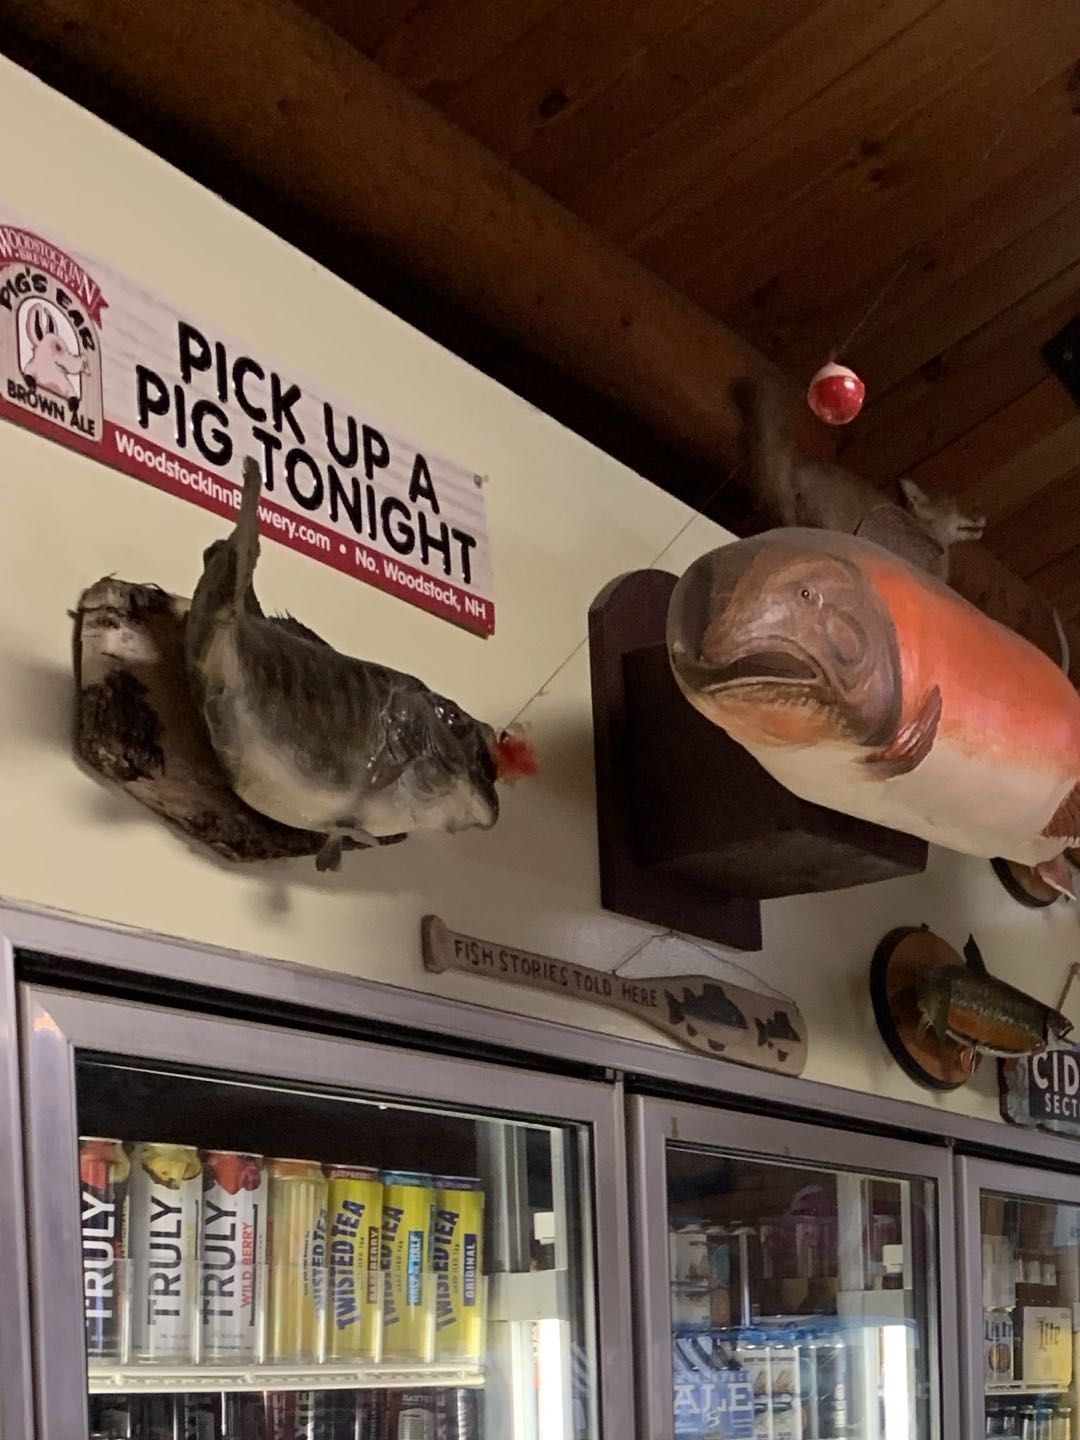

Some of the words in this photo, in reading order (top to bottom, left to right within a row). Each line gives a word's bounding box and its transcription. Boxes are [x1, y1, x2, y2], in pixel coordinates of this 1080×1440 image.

[7, 378, 66, 422] BROWN
[70, 411, 96, 438] ALE
[178, 320, 305, 444] PICK
[322, 401, 390, 482] UP
[408, 451, 440, 514] A
[114, 430, 330, 552] WoodstockInnBwery.com
[355, 549, 380, 575] No.
[383, 560, 462, 613] Woodstock,
[464, 597, 487, 622] NH
[134, 364, 234, 467] PIG
[251, 425, 477, 585] TONIGHT
[454, 938, 494, 967] FISH
[499, 953, 568, 987] STORIES
[572, 969, 612, 997] TOLD
[622, 983, 658, 1008] HERE
[82, 1190, 116, 1326] TRULY
[147, 1196, 183, 1326] TRULY
[202, 1199, 238, 1326] TRULY
[331, 1199, 366, 1238] TEA
[329, 1240, 362, 1331] TWISTED
